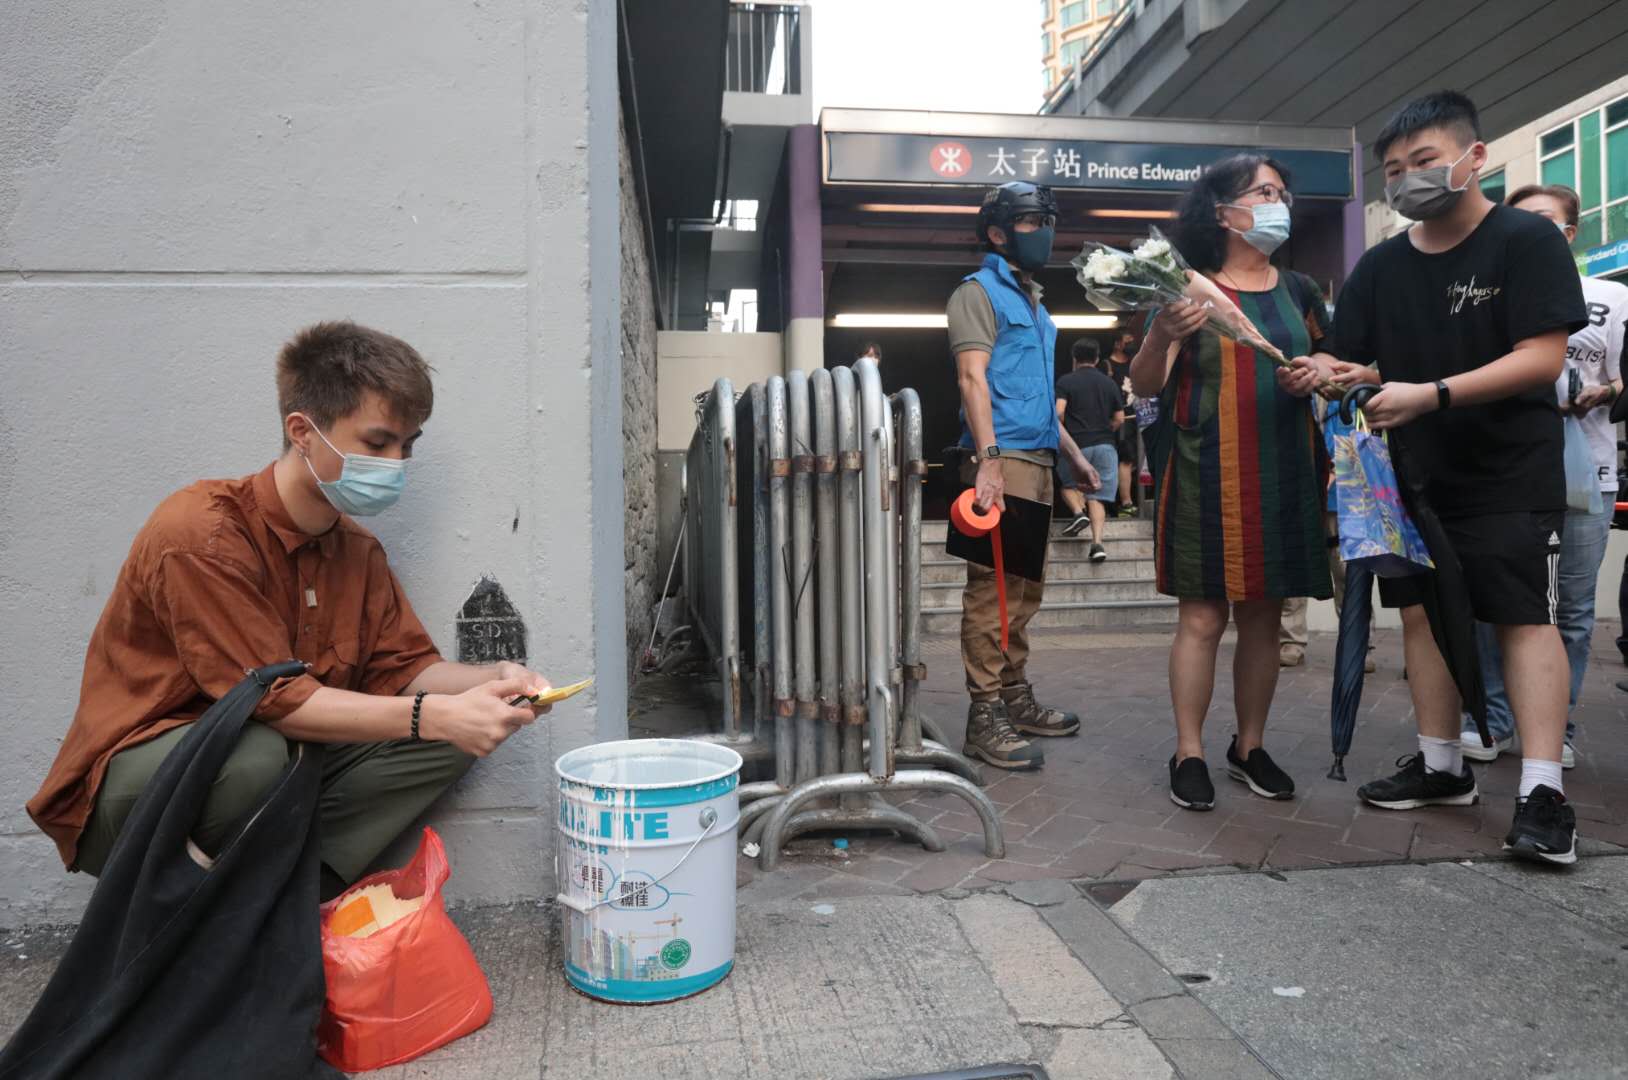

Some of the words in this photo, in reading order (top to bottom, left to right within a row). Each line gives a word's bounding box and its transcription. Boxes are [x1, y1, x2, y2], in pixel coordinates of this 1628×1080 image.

[988, 147, 1081, 179] 太子站
[1087, 162, 1139, 180] Prince
[1141, 163, 1201, 182] Edward
